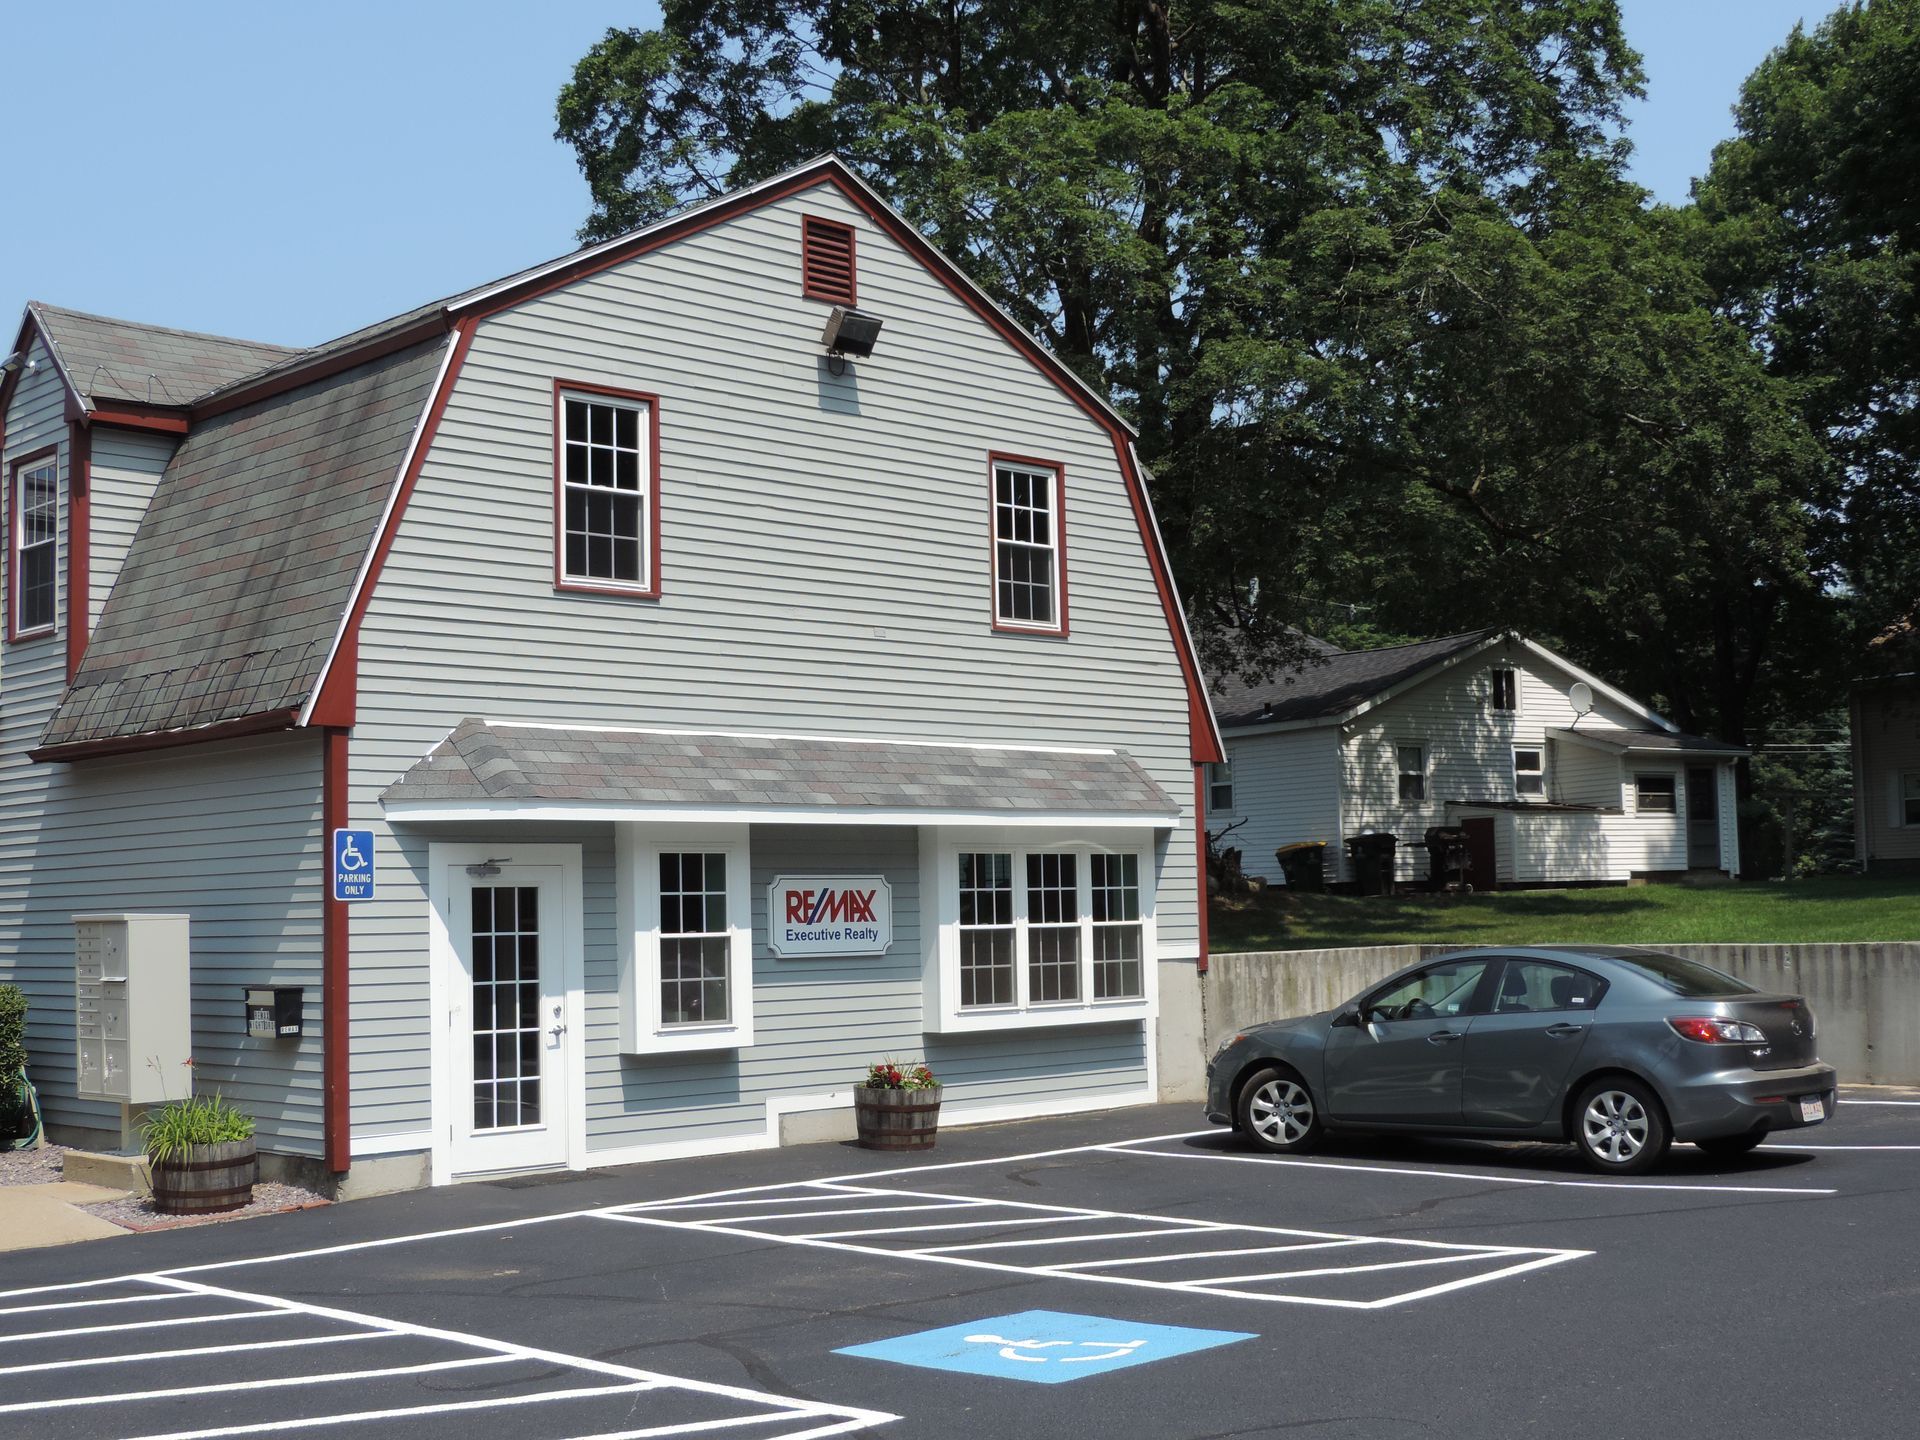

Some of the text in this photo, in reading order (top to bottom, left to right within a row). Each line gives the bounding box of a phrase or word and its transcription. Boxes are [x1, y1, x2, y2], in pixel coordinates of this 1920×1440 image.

[338, 873, 371, 883] PARKING
[344, 885, 365, 895] ONLY
[785, 887, 877, 925] RE/MAX
[786, 927, 878, 942] Executive Realty
